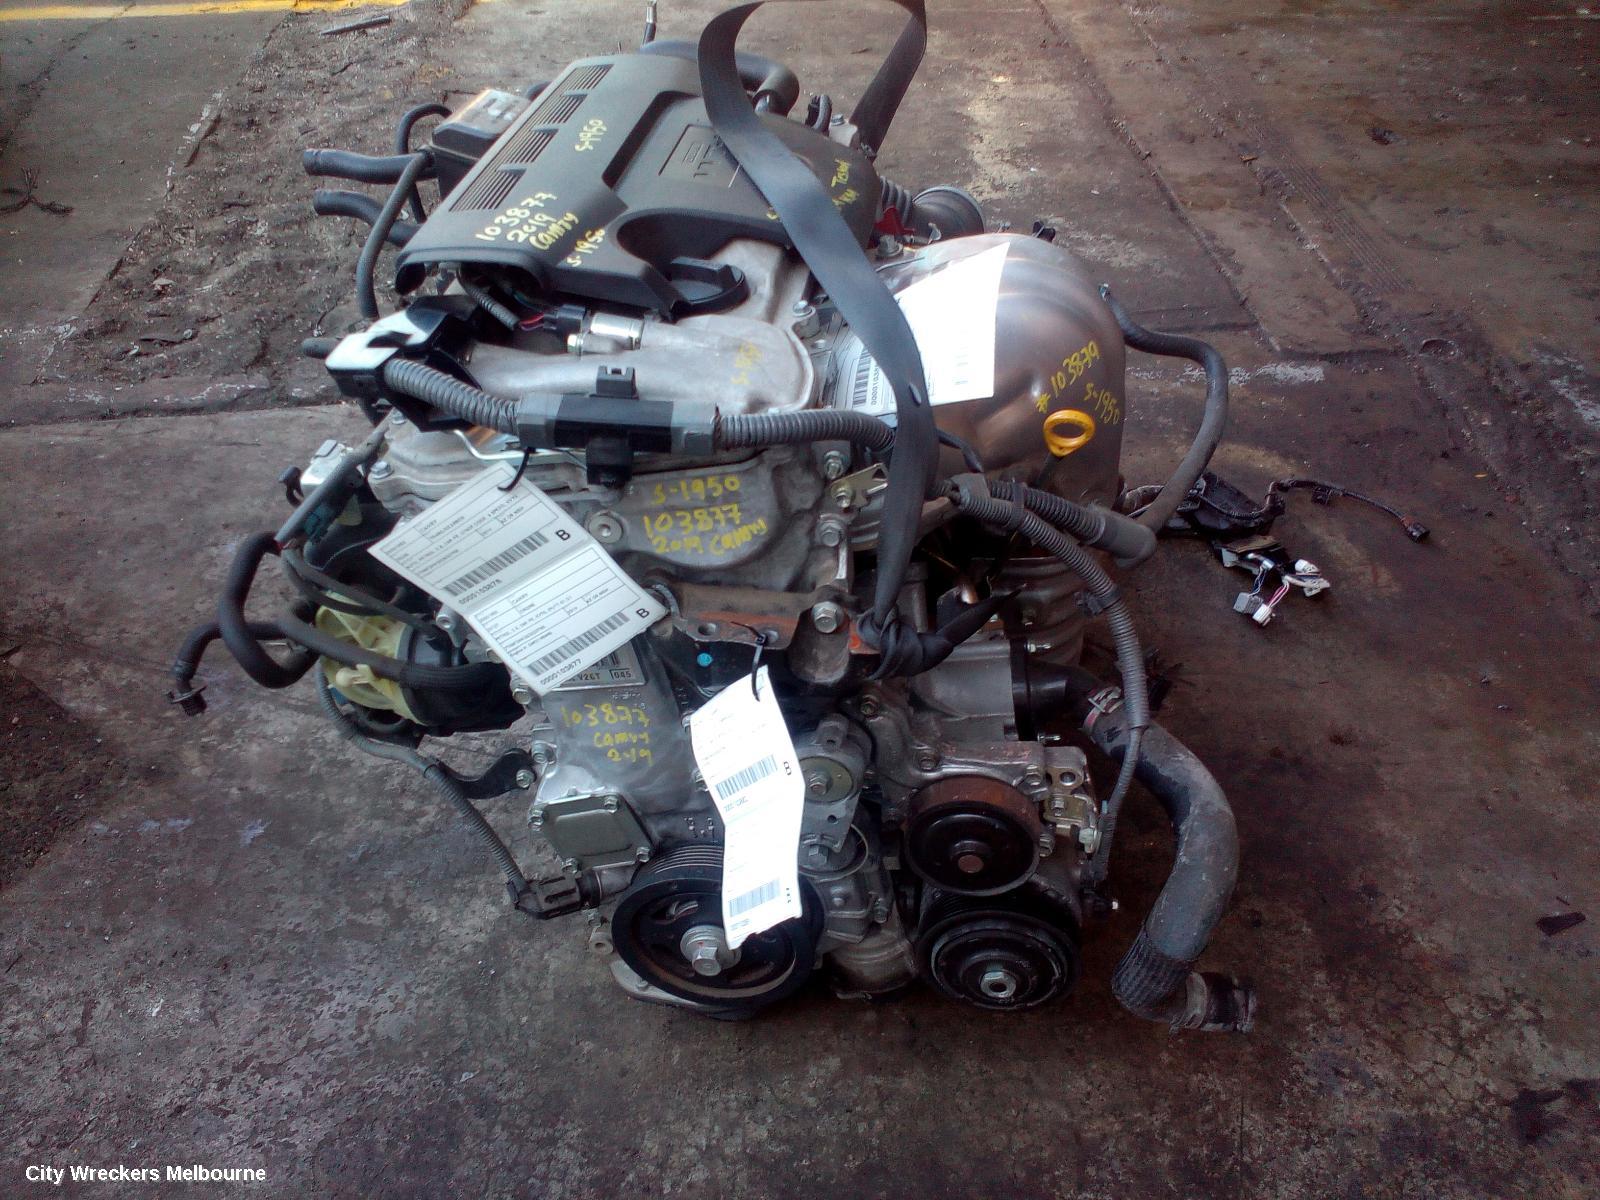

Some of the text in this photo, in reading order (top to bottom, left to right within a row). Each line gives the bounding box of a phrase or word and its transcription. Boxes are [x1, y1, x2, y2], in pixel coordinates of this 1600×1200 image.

[474, 192, 558, 241] 103877
[651, 475, 741, 506] S-1950
[555, 529, 571, 542] B
[643, 503, 742, 540] 103877
[638, 608, 650, 620] B
